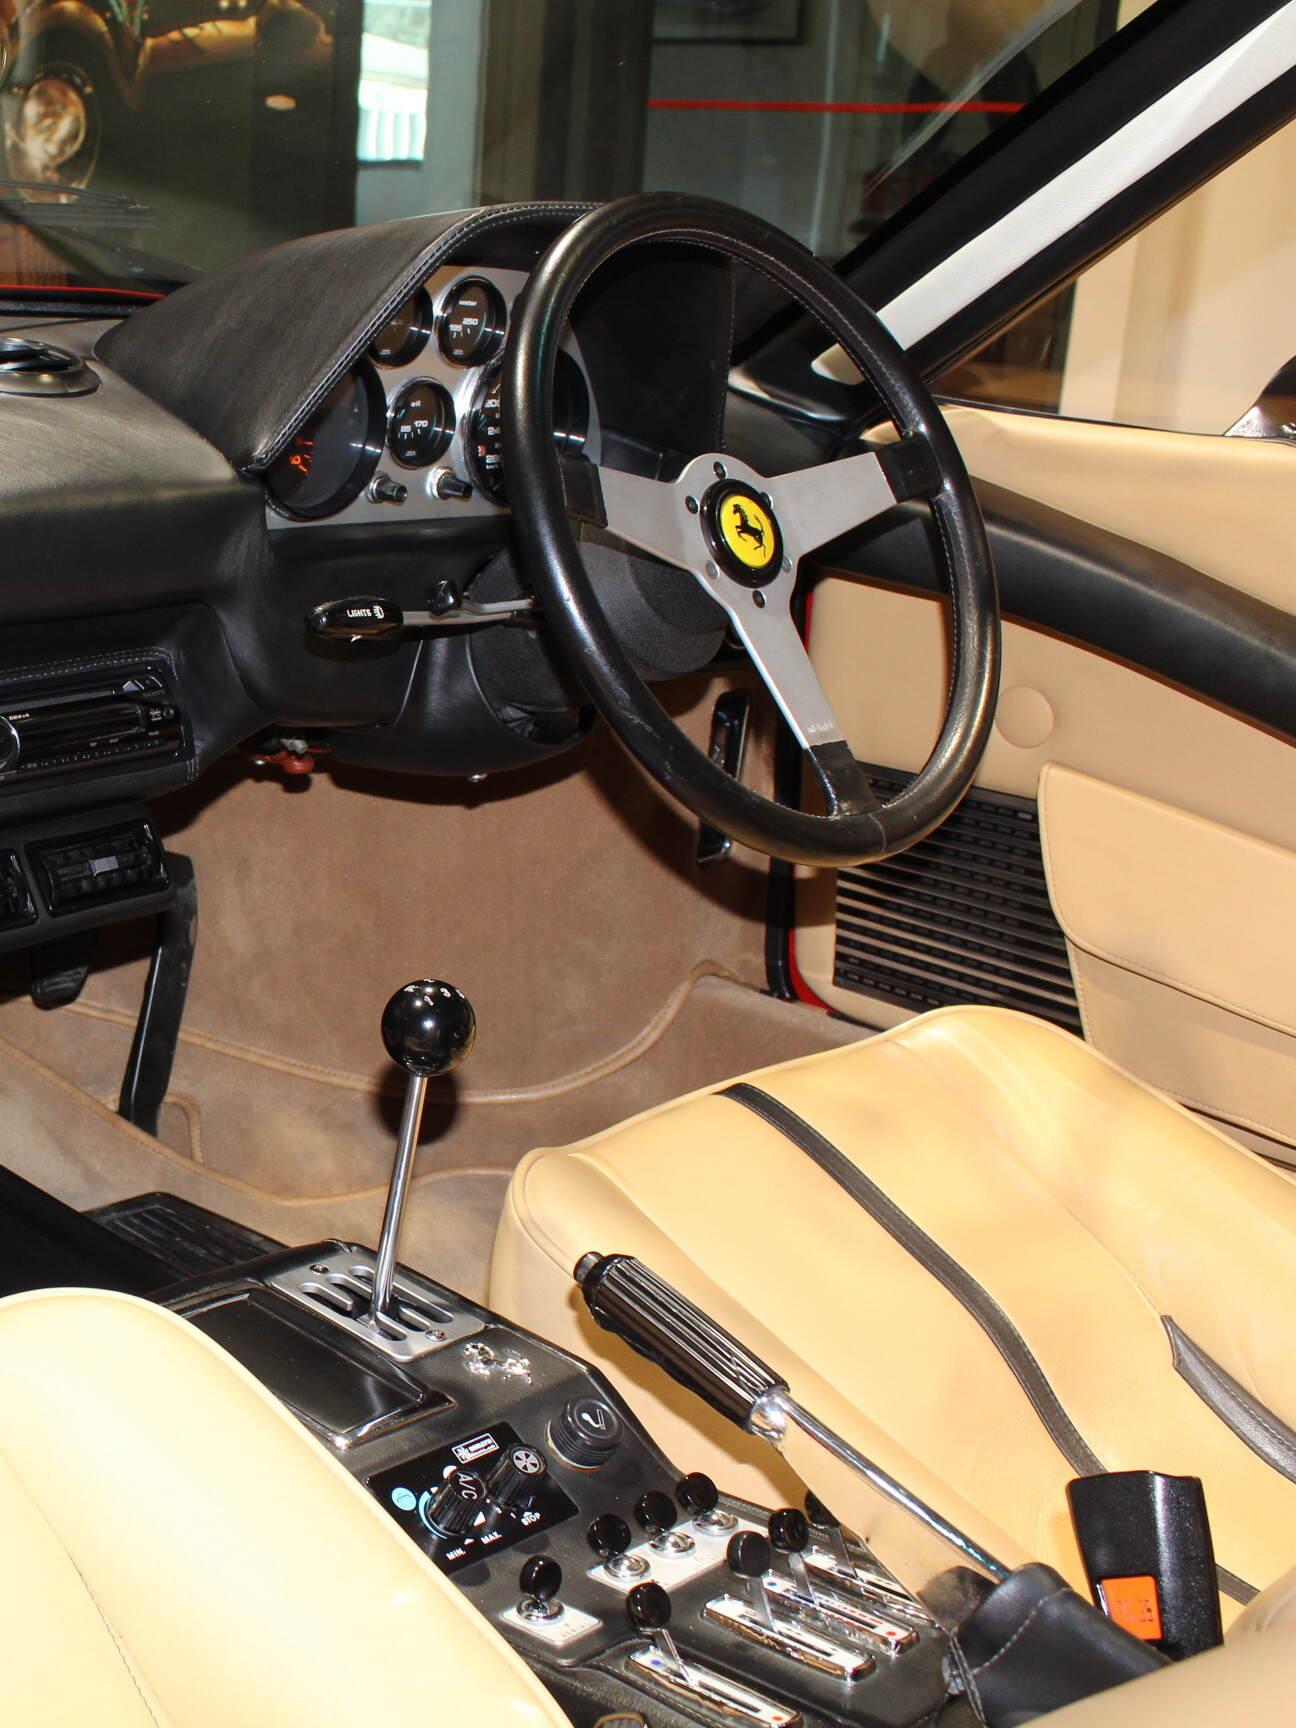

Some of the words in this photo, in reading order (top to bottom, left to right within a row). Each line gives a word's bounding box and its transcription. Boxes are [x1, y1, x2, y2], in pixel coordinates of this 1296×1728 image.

[462, 317, 479, 326] 250
[414, 420, 429, 428] 170
[346, 608, 372, 618] LIGHTS
[458, 1471, 478, 1500] A/C
[521, 1512, 541, 1527] STOP
[480, 1531, 504, 1546] MAX.
[446, 1549, 468, 1561] MIN.
